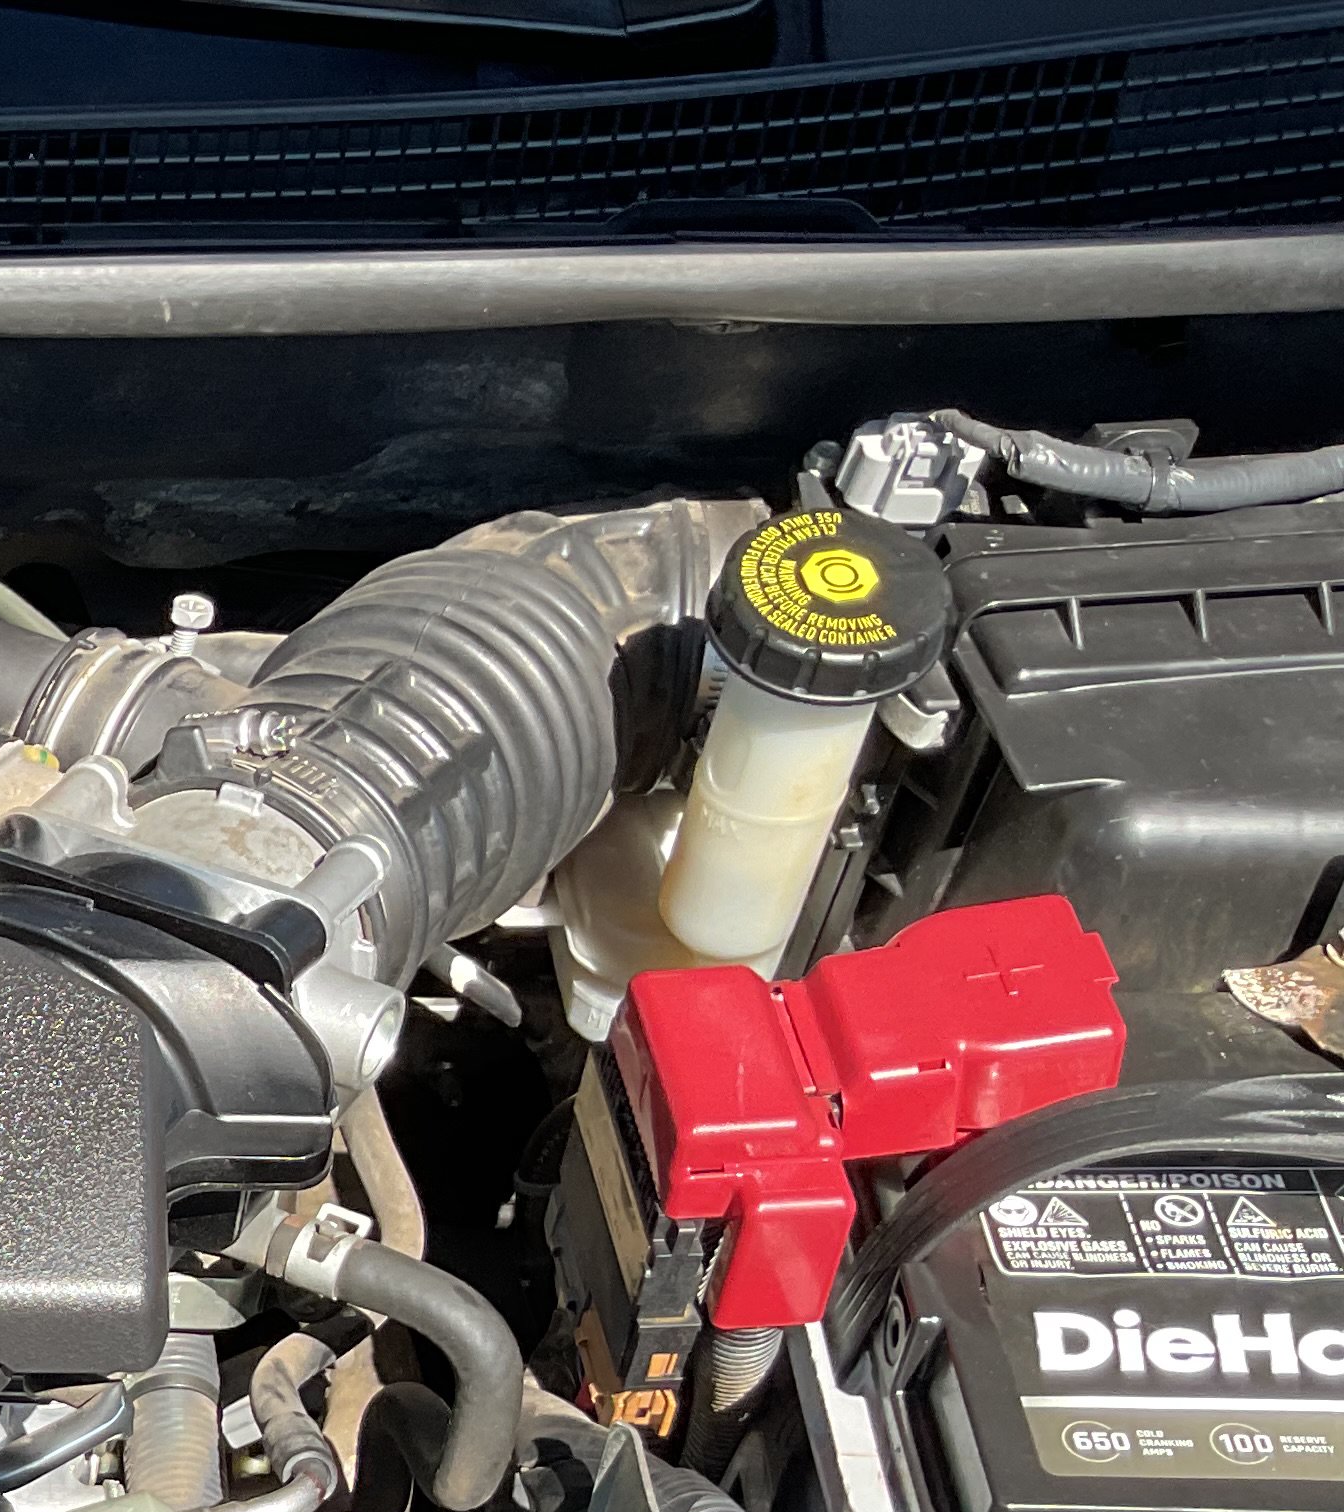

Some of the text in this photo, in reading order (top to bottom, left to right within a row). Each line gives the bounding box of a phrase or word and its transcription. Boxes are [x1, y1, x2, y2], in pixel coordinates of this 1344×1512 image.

[780, 514, 813, 532] ONLY
[815, 512, 842, 524] USE
[741, 549, 762, 577] FLUID
[760, 523, 883, 631] CLEAN FILLER CAP BEFORE REMOVING
[778, 559, 812, 606] WARNING
[742, 578, 768, 606] FROM
[758, 604, 773, 615] A
[767, 610, 817, 641] SEALED
[818, 625, 897, 645] CONTAINER
[1140, 1219, 1161, 1232] NO
[998, 1227, 1047, 1238] SHIELD
[1228, 1227, 1329, 1239] SULFURIC ACID
[1155, 1235, 1206, 1245] SPARKS
[1002, 1241, 1128, 1252] EXPLOSIVE GASES
[1234, 1242, 1305, 1253] CAN CAUSE
[1006, 1251, 1136, 1263] CAN CAUSE BLINDNESS
[1160, 1249, 1212, 1259] FLAMES
[1237, 1252, 1331, 1263] BLINDNESS OR
[1011, 1260, 1029, 1269] OR
[1166, 1261, 1228, 1270] SMOKING
[1242, 1263, 1291, 1273] SEVERE
[1136, 1430, 1164, 1438] COLD
[1073, 1431, 1131, 1451] 650
[1139, 1439, 1194, 1448] CRANKING
[1219, 1433, 1274, 1453] 100
[1279, 1435, 1327, 1445] RESERVE
[1143, 1448, 1173, 1456] AMPS
[1283, 1444, 1335, 1454] CAPACITY
